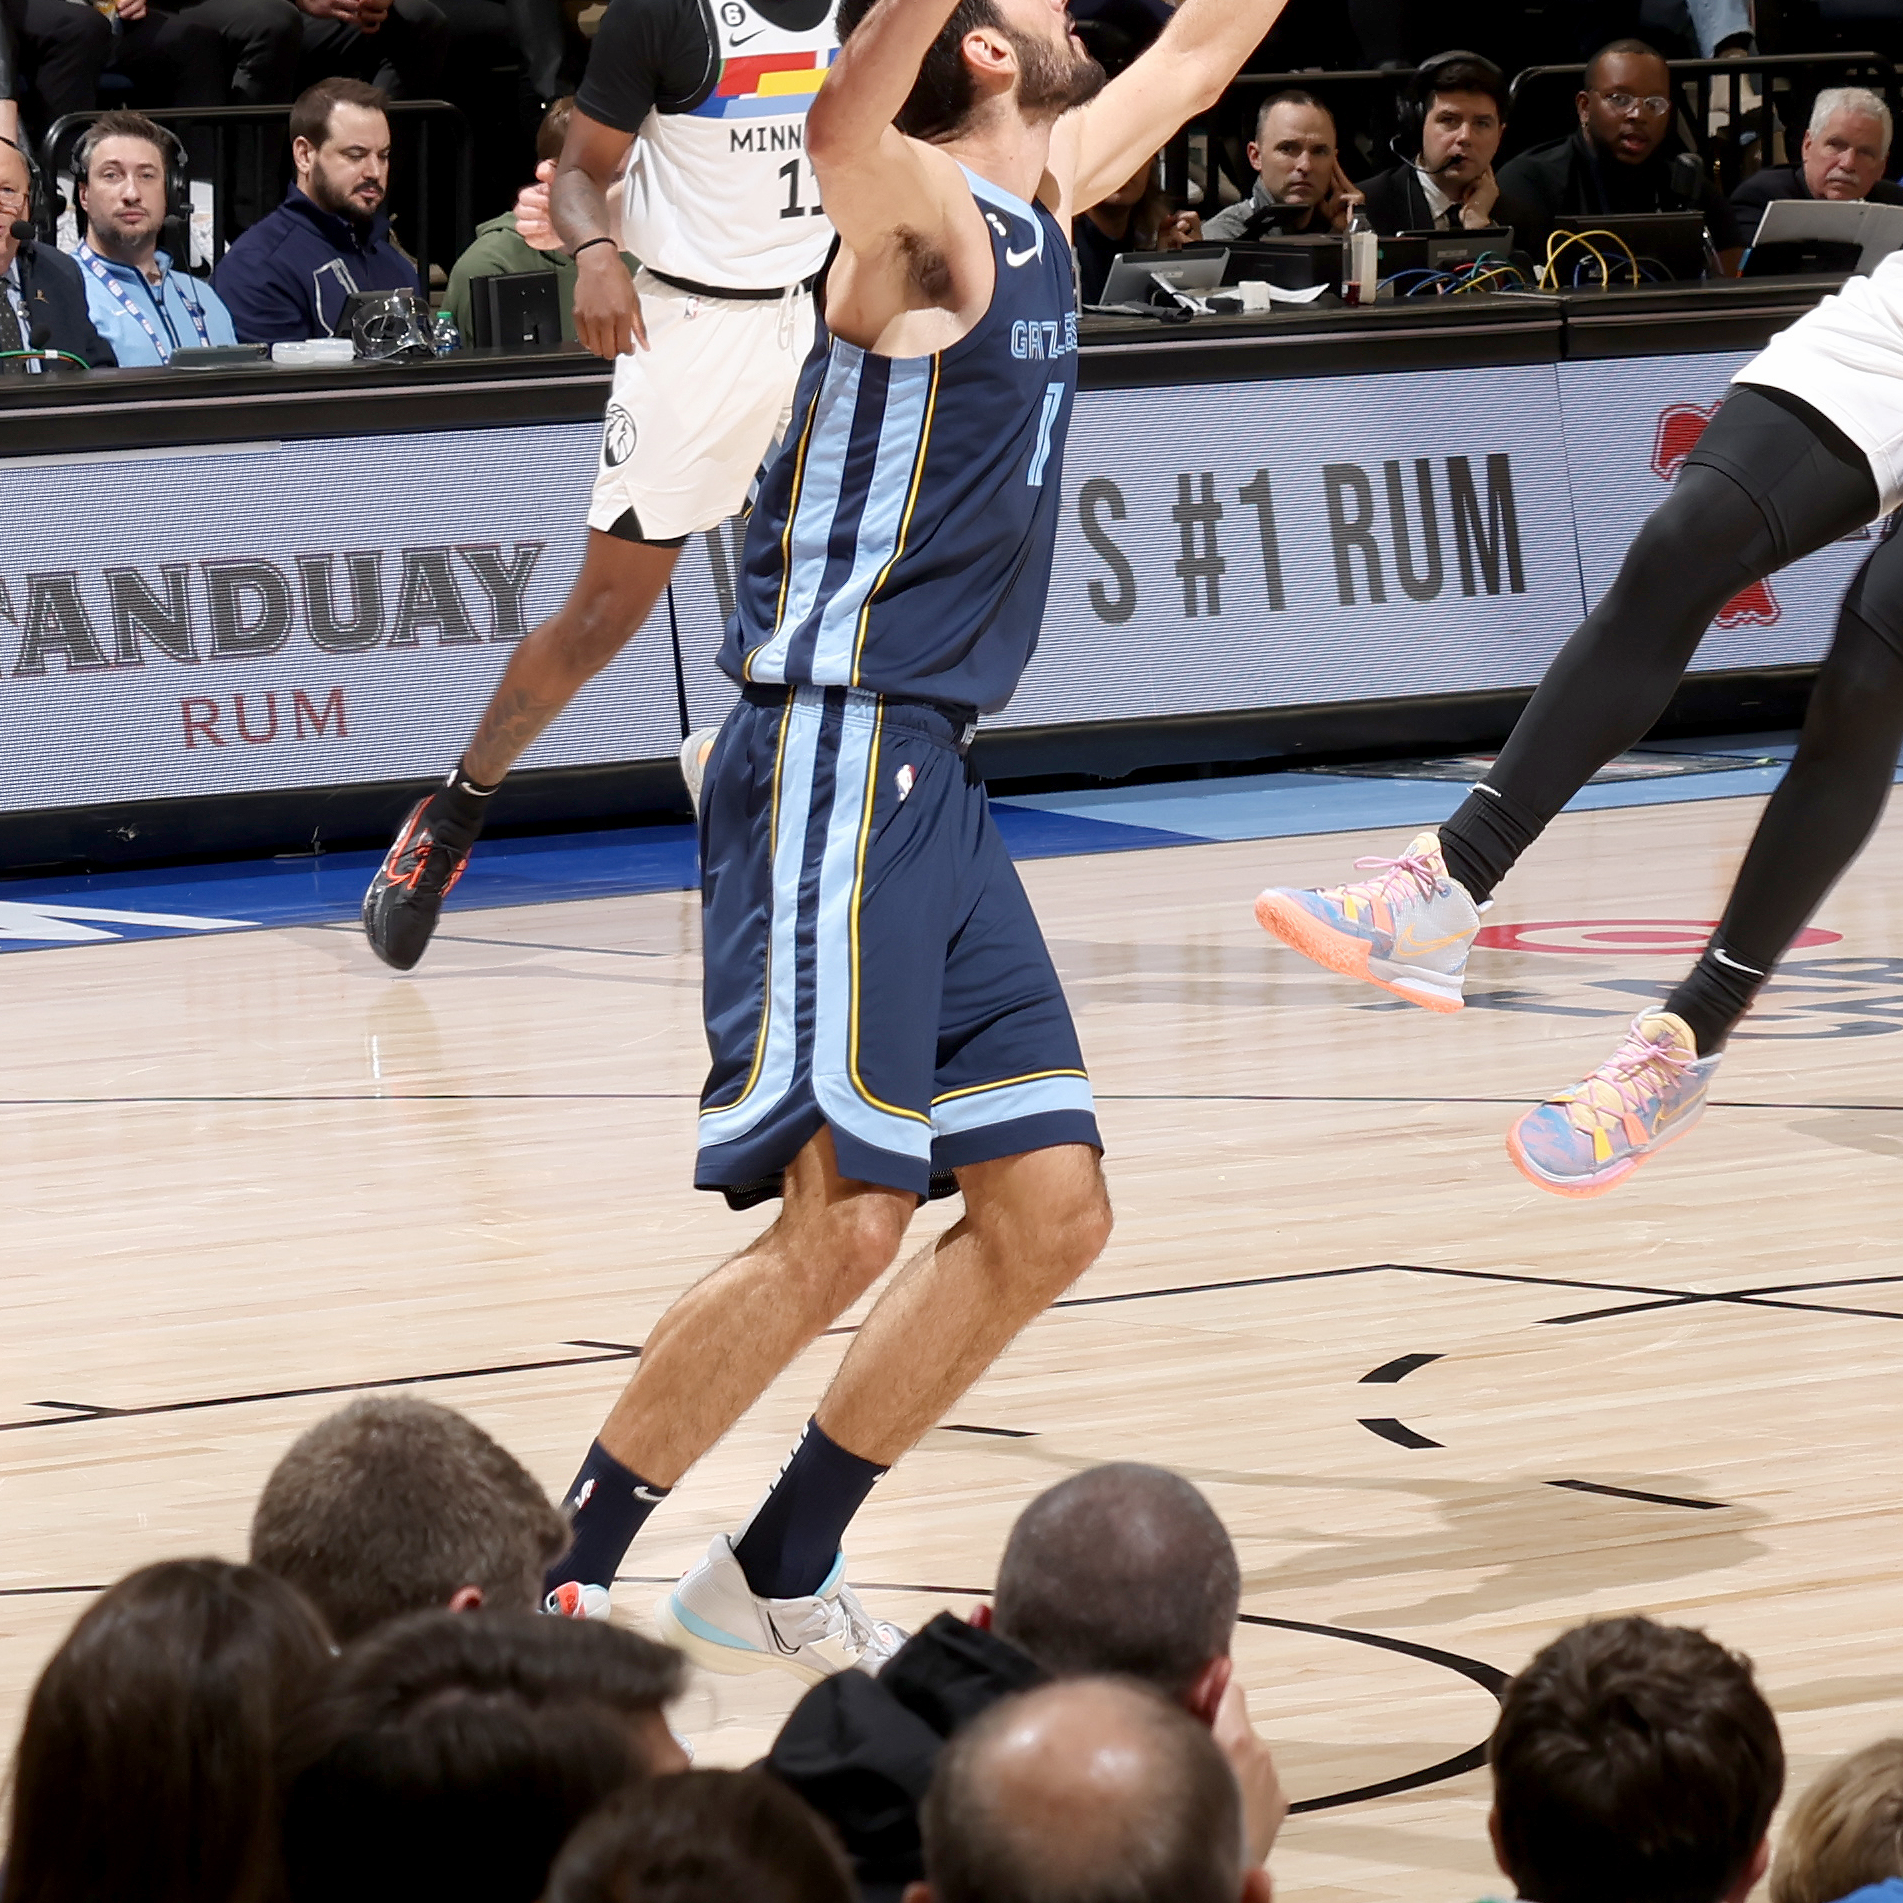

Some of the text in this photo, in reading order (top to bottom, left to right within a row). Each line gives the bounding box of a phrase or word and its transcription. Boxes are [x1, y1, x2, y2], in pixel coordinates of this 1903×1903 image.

[725, 3, 746, 26] 6
[1171, 468, 1286, 618] #1
[1323, 453, 1526, 607] RUM
[180, 685, 351, 749] RUM
